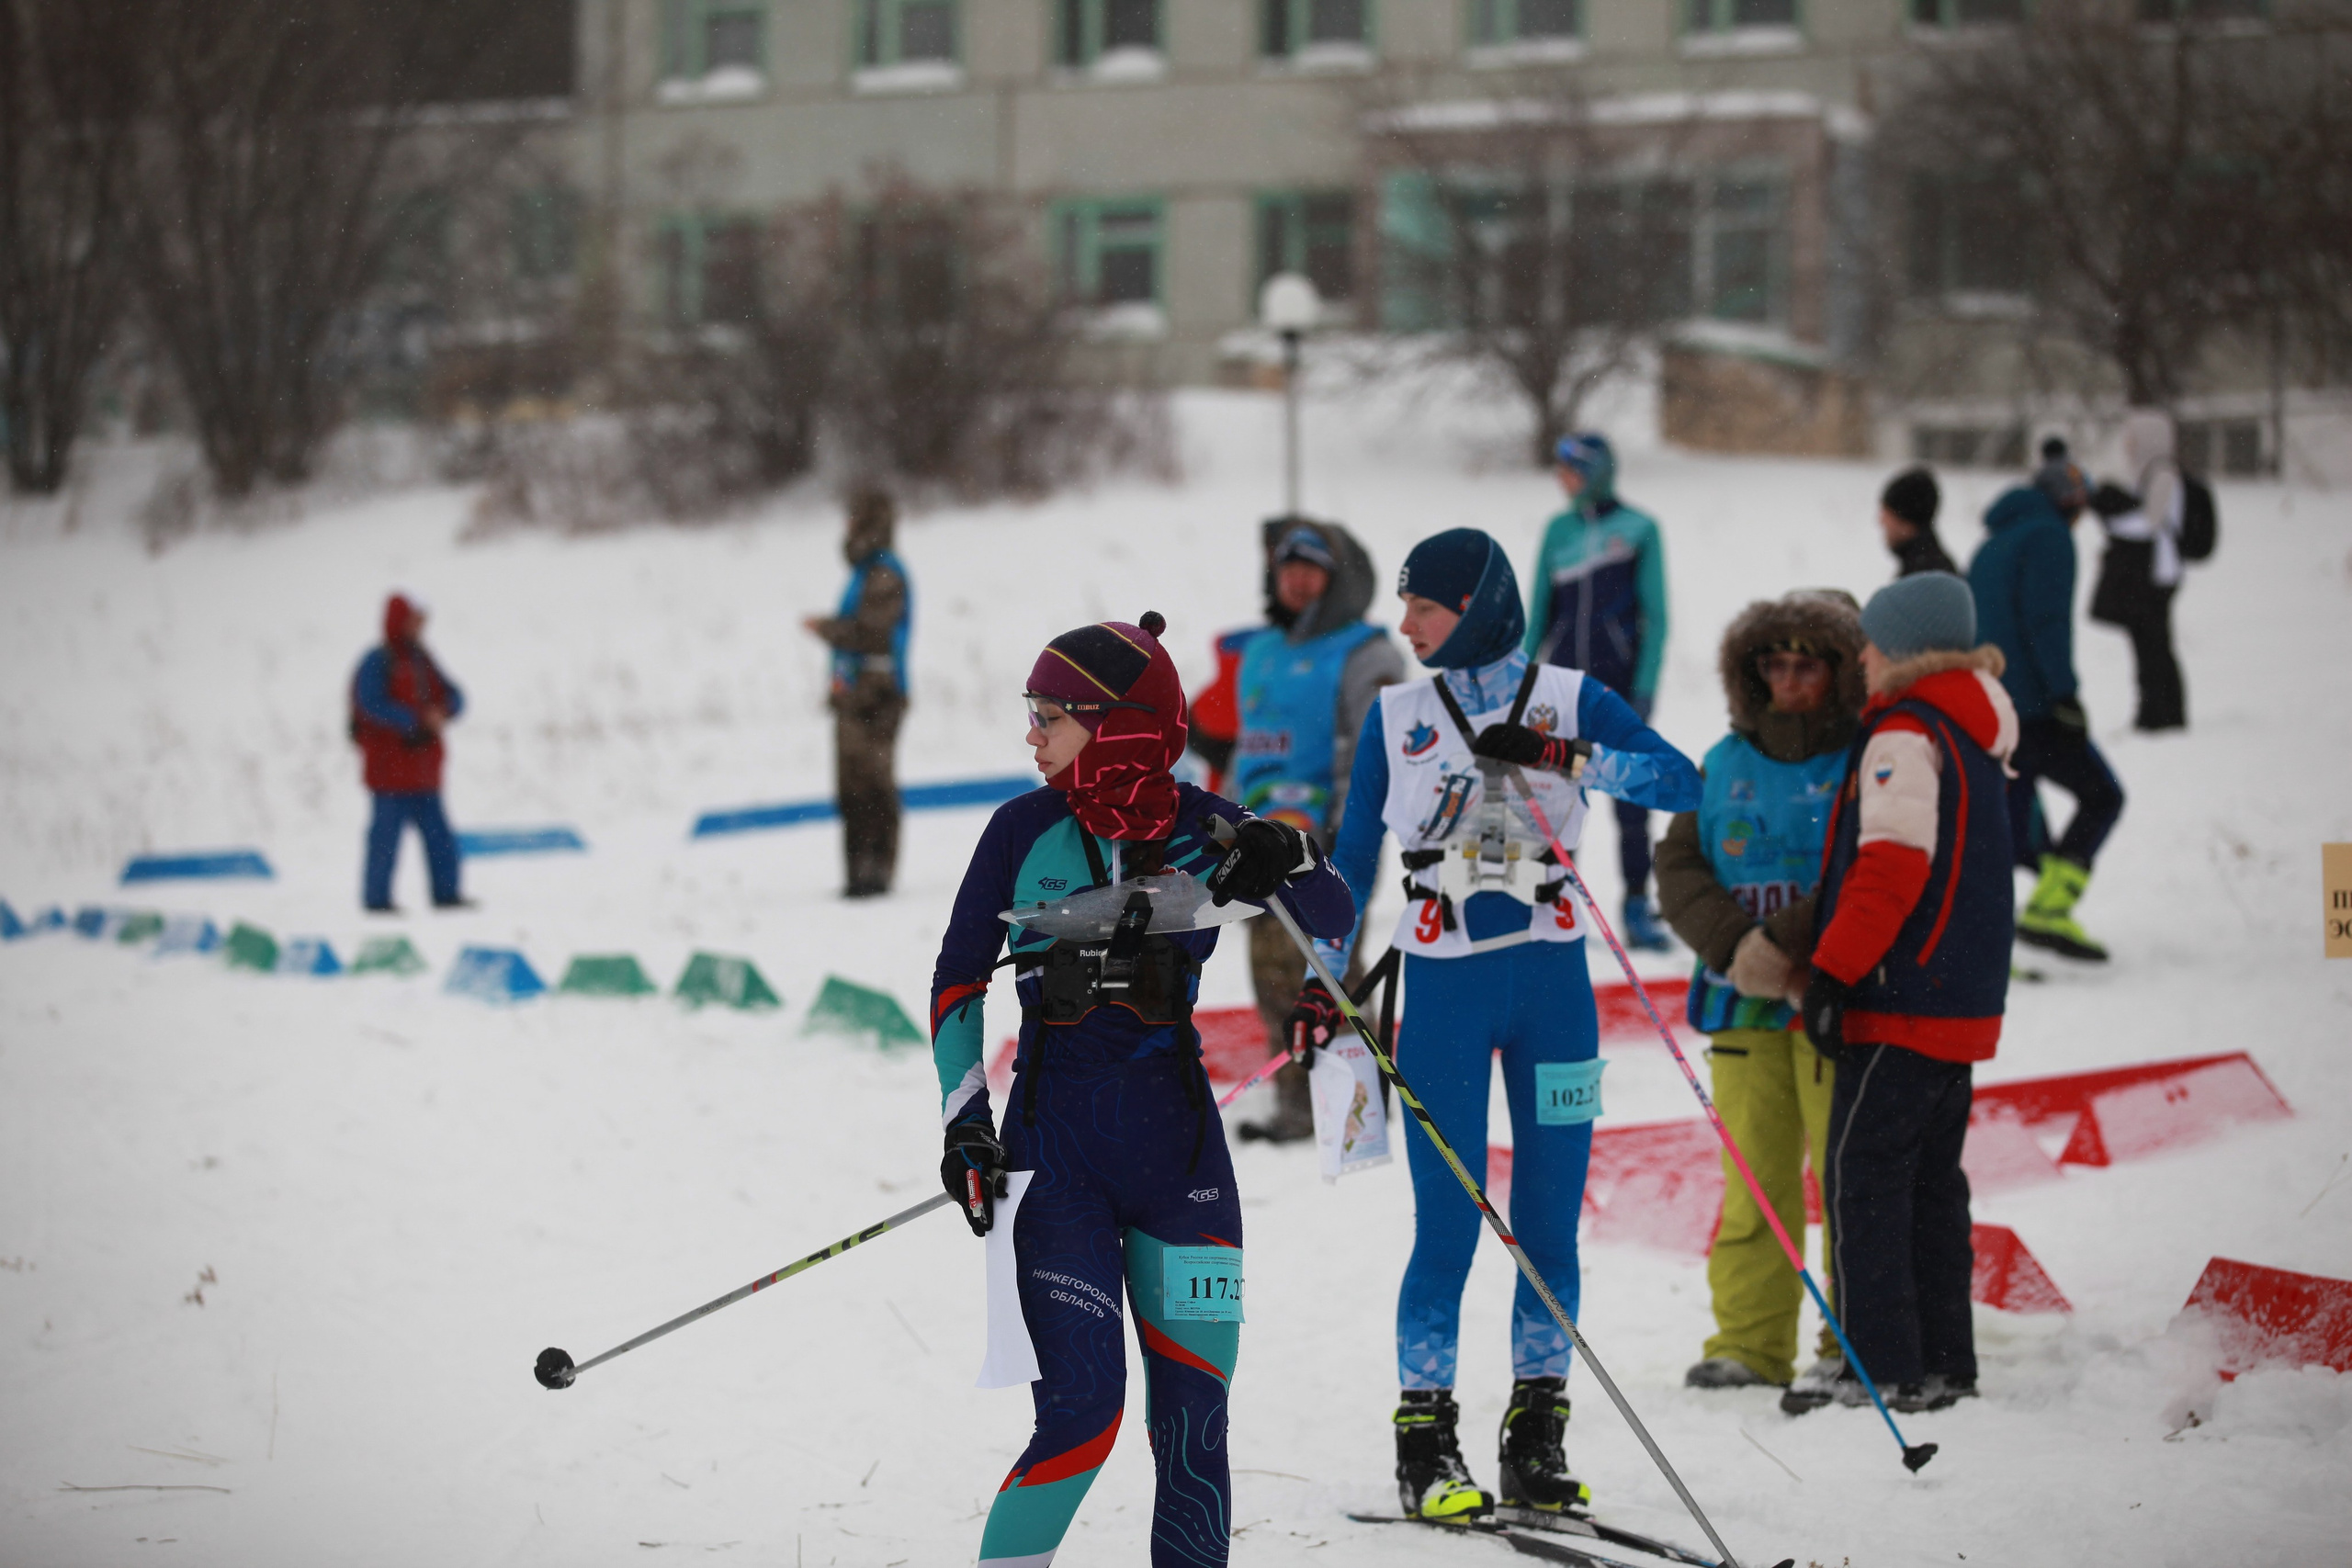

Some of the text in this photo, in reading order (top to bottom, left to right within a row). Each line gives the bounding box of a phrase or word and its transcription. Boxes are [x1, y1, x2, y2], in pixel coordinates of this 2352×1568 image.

[1044, 878, 1069, 891] GS
[2333, 889, 2352, 910] П
[1195, 1188, 1219, 1202] GS
[1032, 1268, 1123, 1321] НИЖЕГОРОДСКАЯ
[1188, 1276, 1240, 1301] 117.2
[1049, 1289, 1105, 1319] ОБЛАСТЬ
